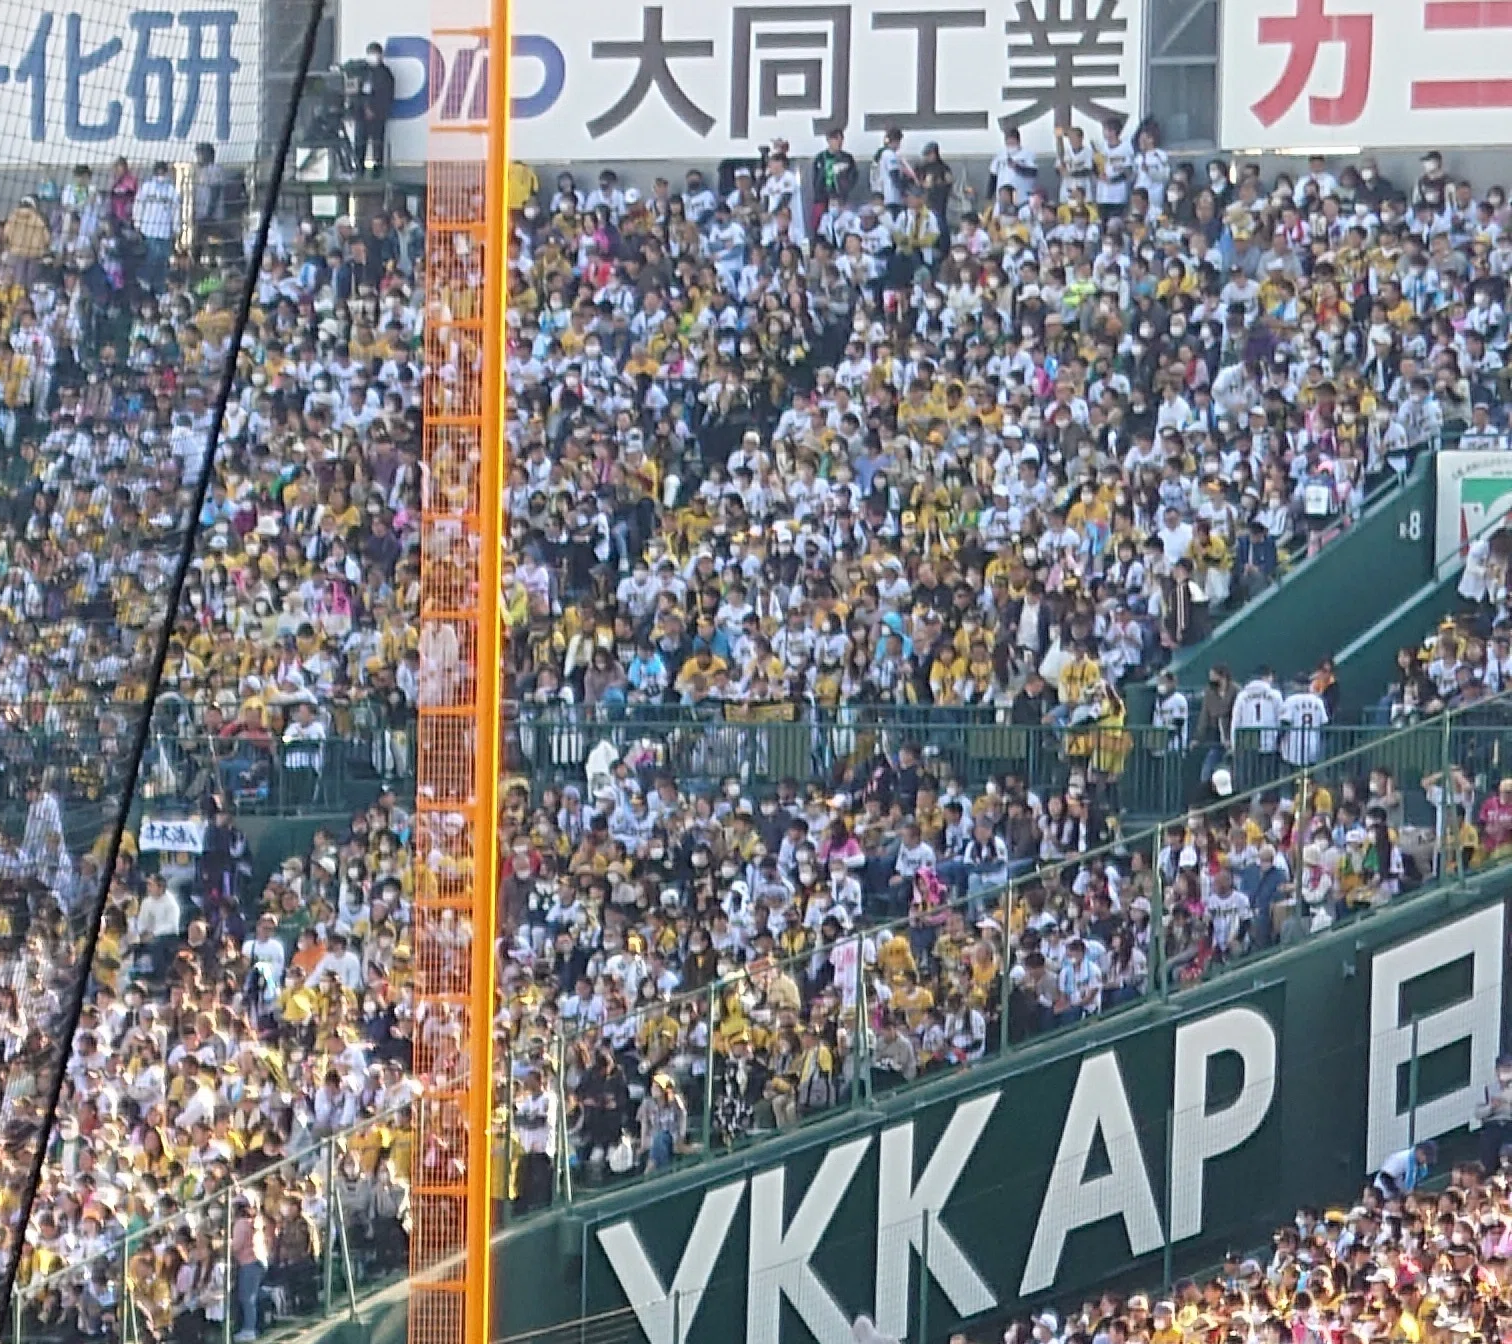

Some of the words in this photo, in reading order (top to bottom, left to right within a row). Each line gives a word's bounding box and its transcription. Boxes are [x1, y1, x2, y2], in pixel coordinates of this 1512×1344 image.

[585, 4, 1130, 141] 大同工業
[1018, 1006, 1278, 1298] AP
